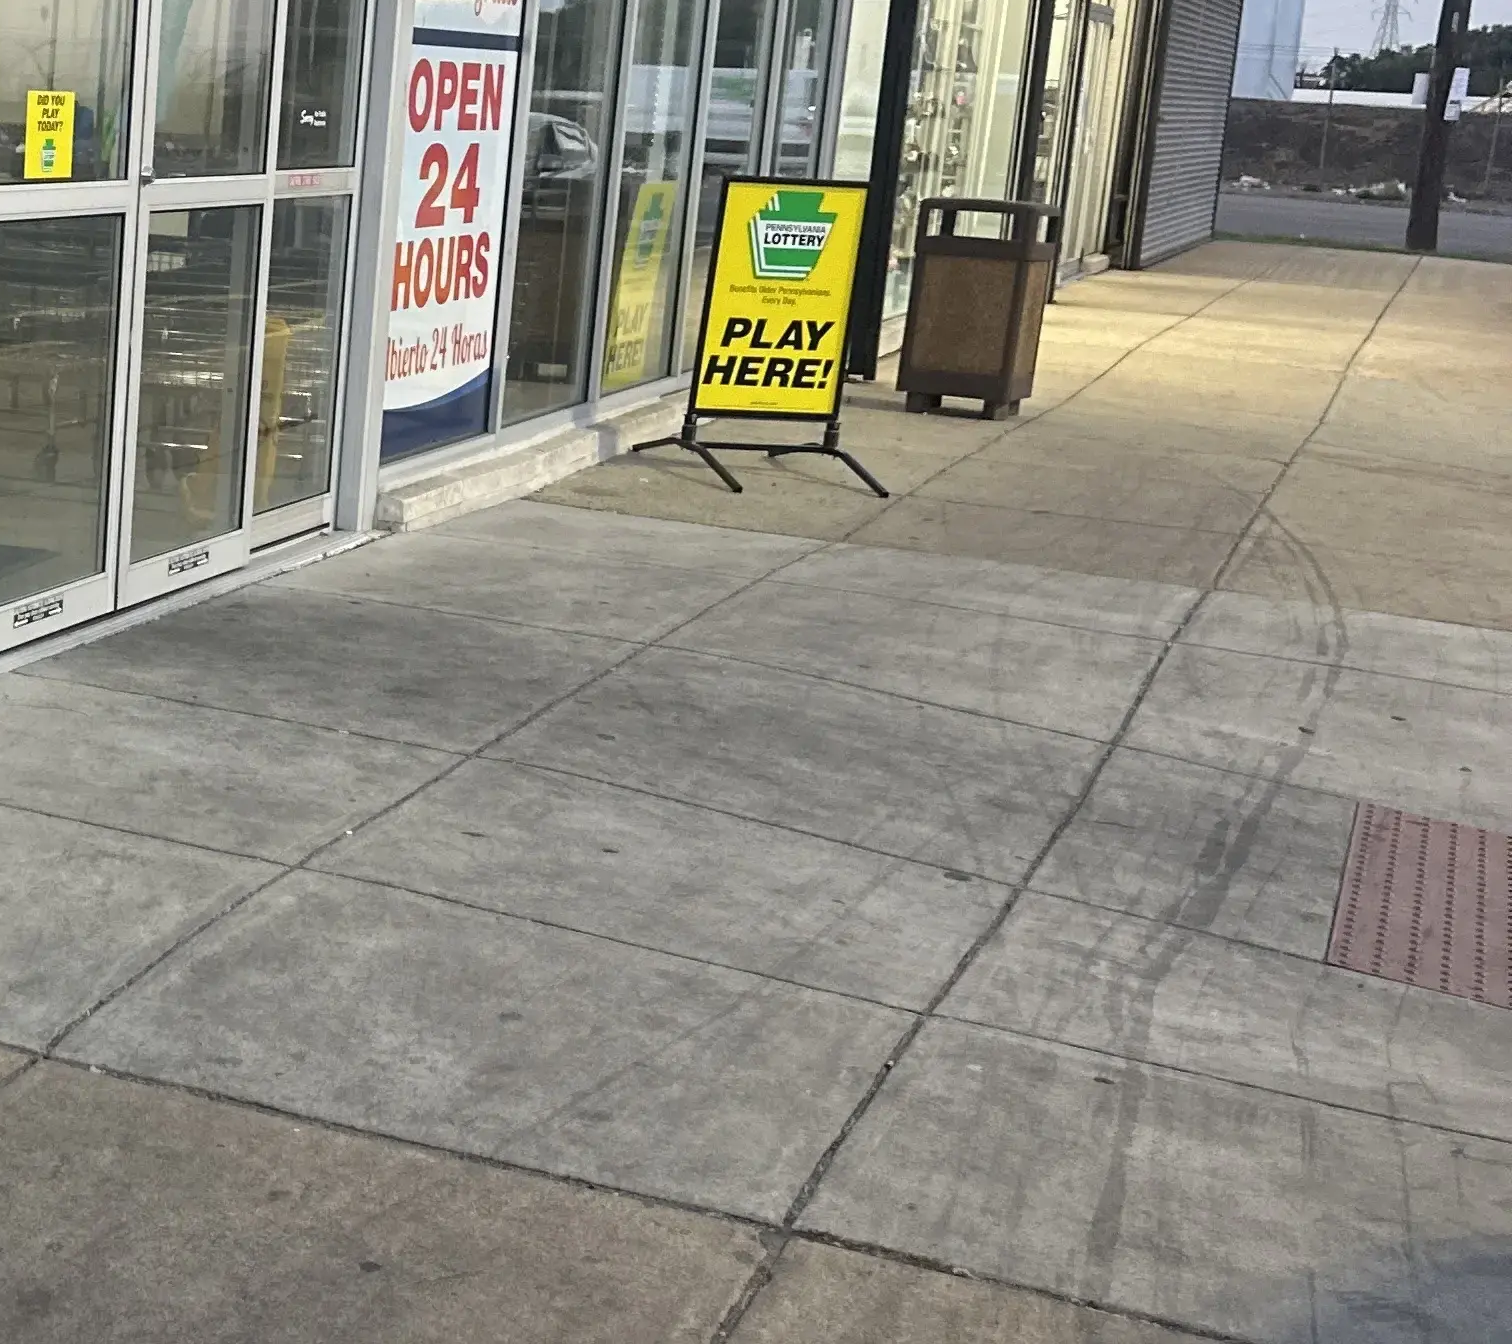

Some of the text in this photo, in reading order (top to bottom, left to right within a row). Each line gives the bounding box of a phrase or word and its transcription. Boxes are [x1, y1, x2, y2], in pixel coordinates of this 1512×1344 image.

[37, 95, 66, 106] DID YOU
[407, 57, 506, 133] OPEN
[37, 120, 64, 132] TODAY?
[42, 107, 60, 119] PLAY
[413, 142, 481, 229] 24
[763, 232, 825, 247] LOTTERY
[765, 223, 826, 233] PENNSYLVANIA
[390, 231, 490, 312] HOURS
[430, 325, 449, 371] 24
[451, 322, 488, 366] Horas
[719, 316, 836, 352] PLAY
[701, 355, 834, 390] HERE!
